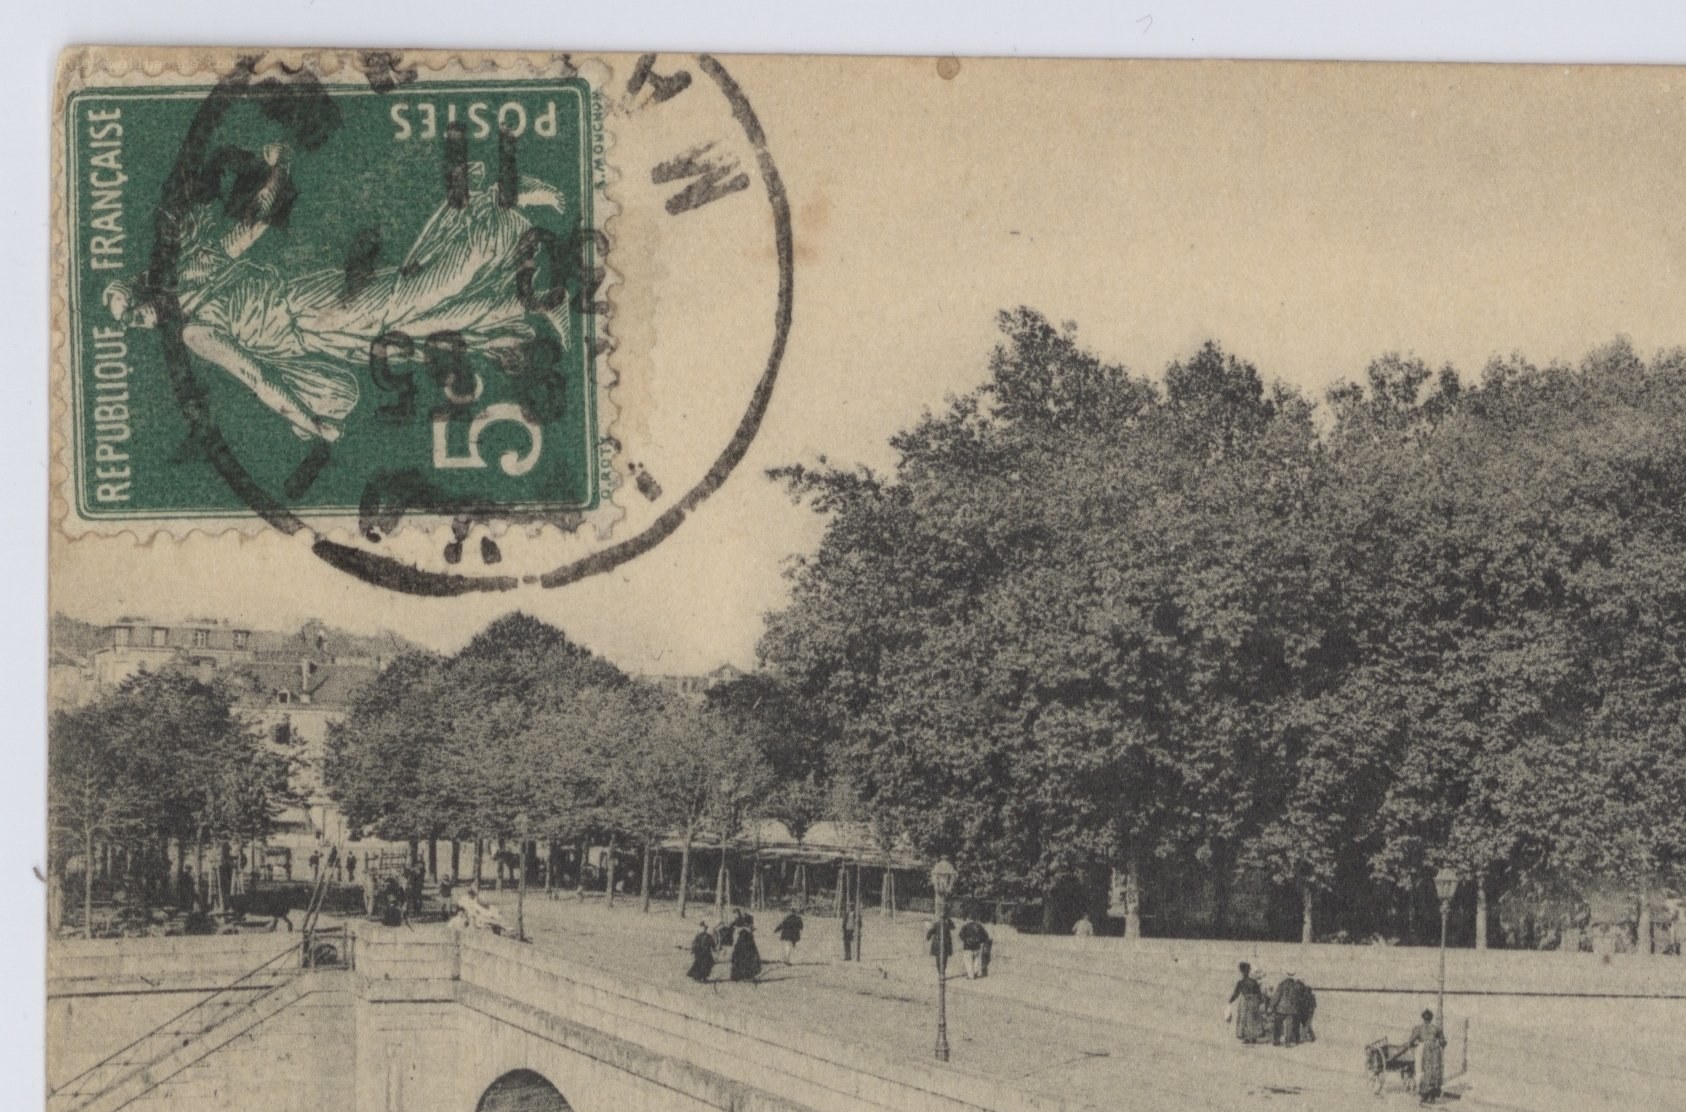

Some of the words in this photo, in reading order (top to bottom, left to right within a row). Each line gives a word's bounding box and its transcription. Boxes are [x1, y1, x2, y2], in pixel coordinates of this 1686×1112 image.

[88, 107, 128, 270] FRANÇAISE
[390, 101, 557, 140] POSTES
[92, 325, 133, 502] REPUBLIQUE
